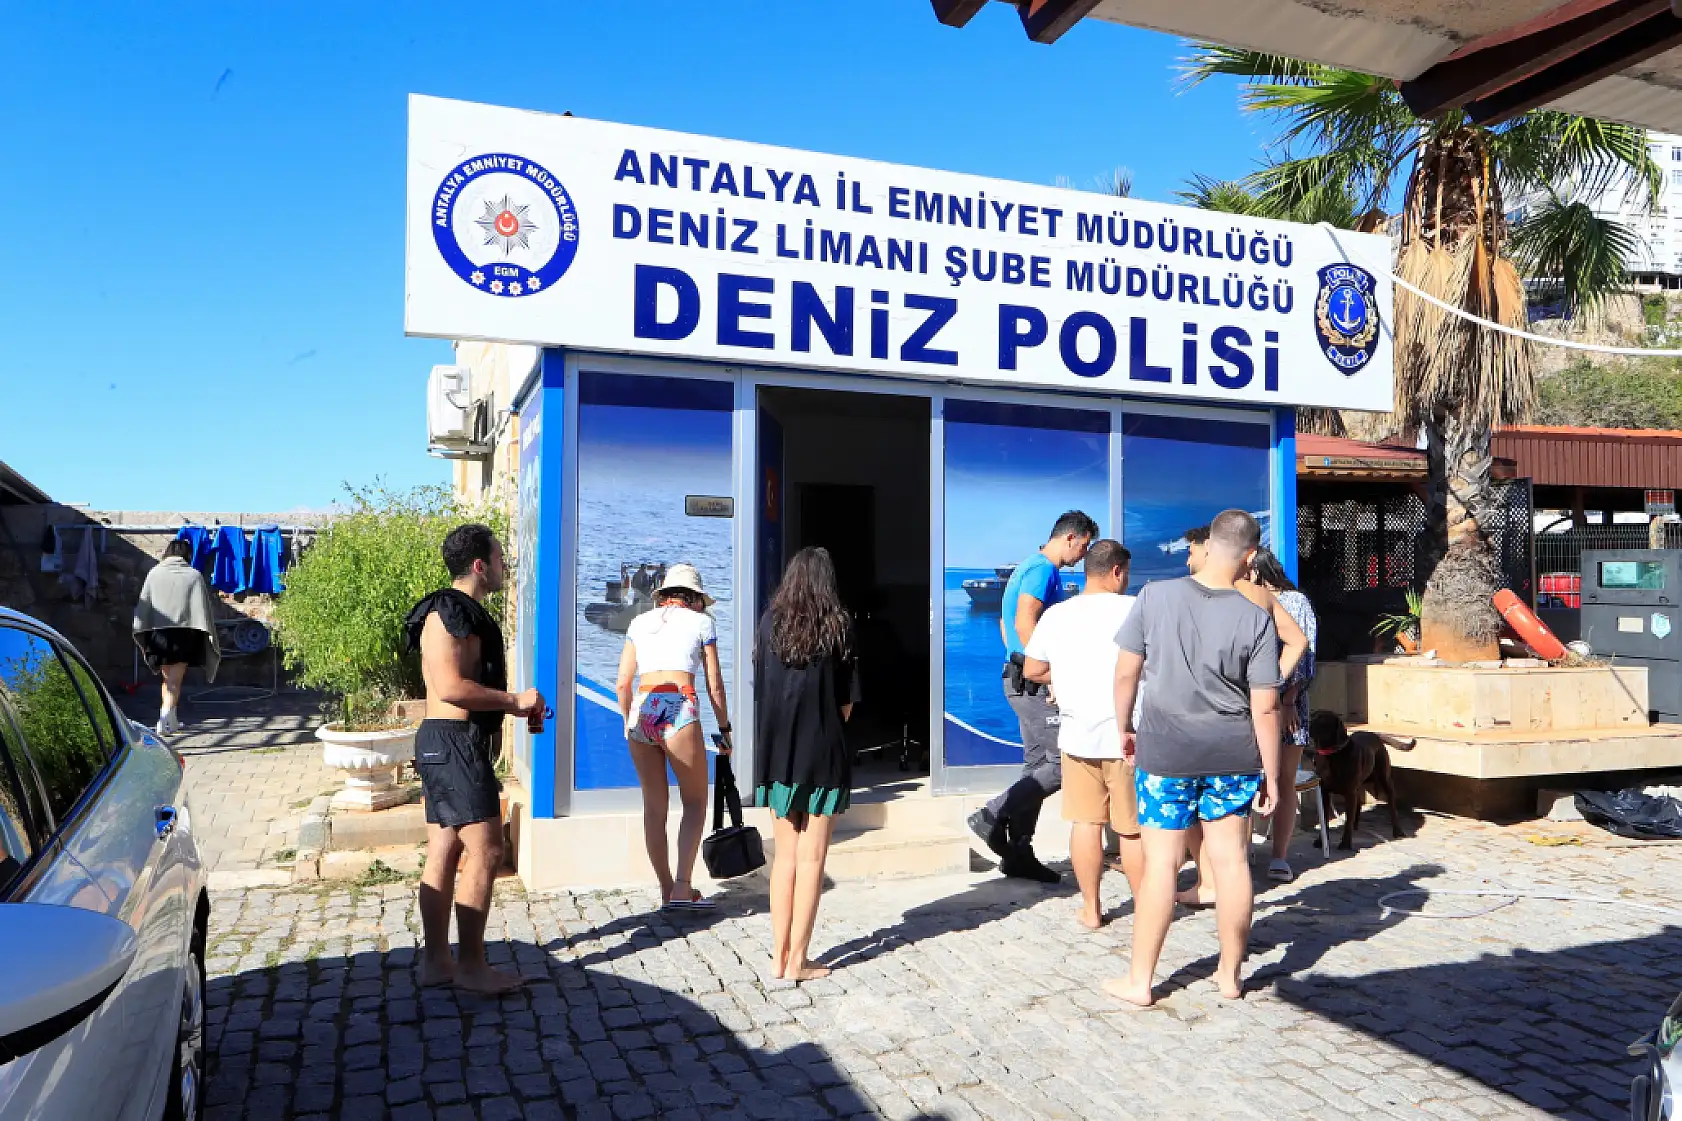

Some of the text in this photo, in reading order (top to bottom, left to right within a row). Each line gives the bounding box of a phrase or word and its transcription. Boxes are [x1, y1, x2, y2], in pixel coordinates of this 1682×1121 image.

[436, 155, 576, 241] ANTALYA EMNİYET MÜDÜRLÜĞÜ
[614, 148, 1294, 267] ANTALYA İL EMNİYET MÜDÜRLÜĞÜ
[494, 265, 519, 279] EGM
[612, 203, 1294, 315] DENİZ LİMANI ŞUBE MÜDÜRLÜĞÜ
